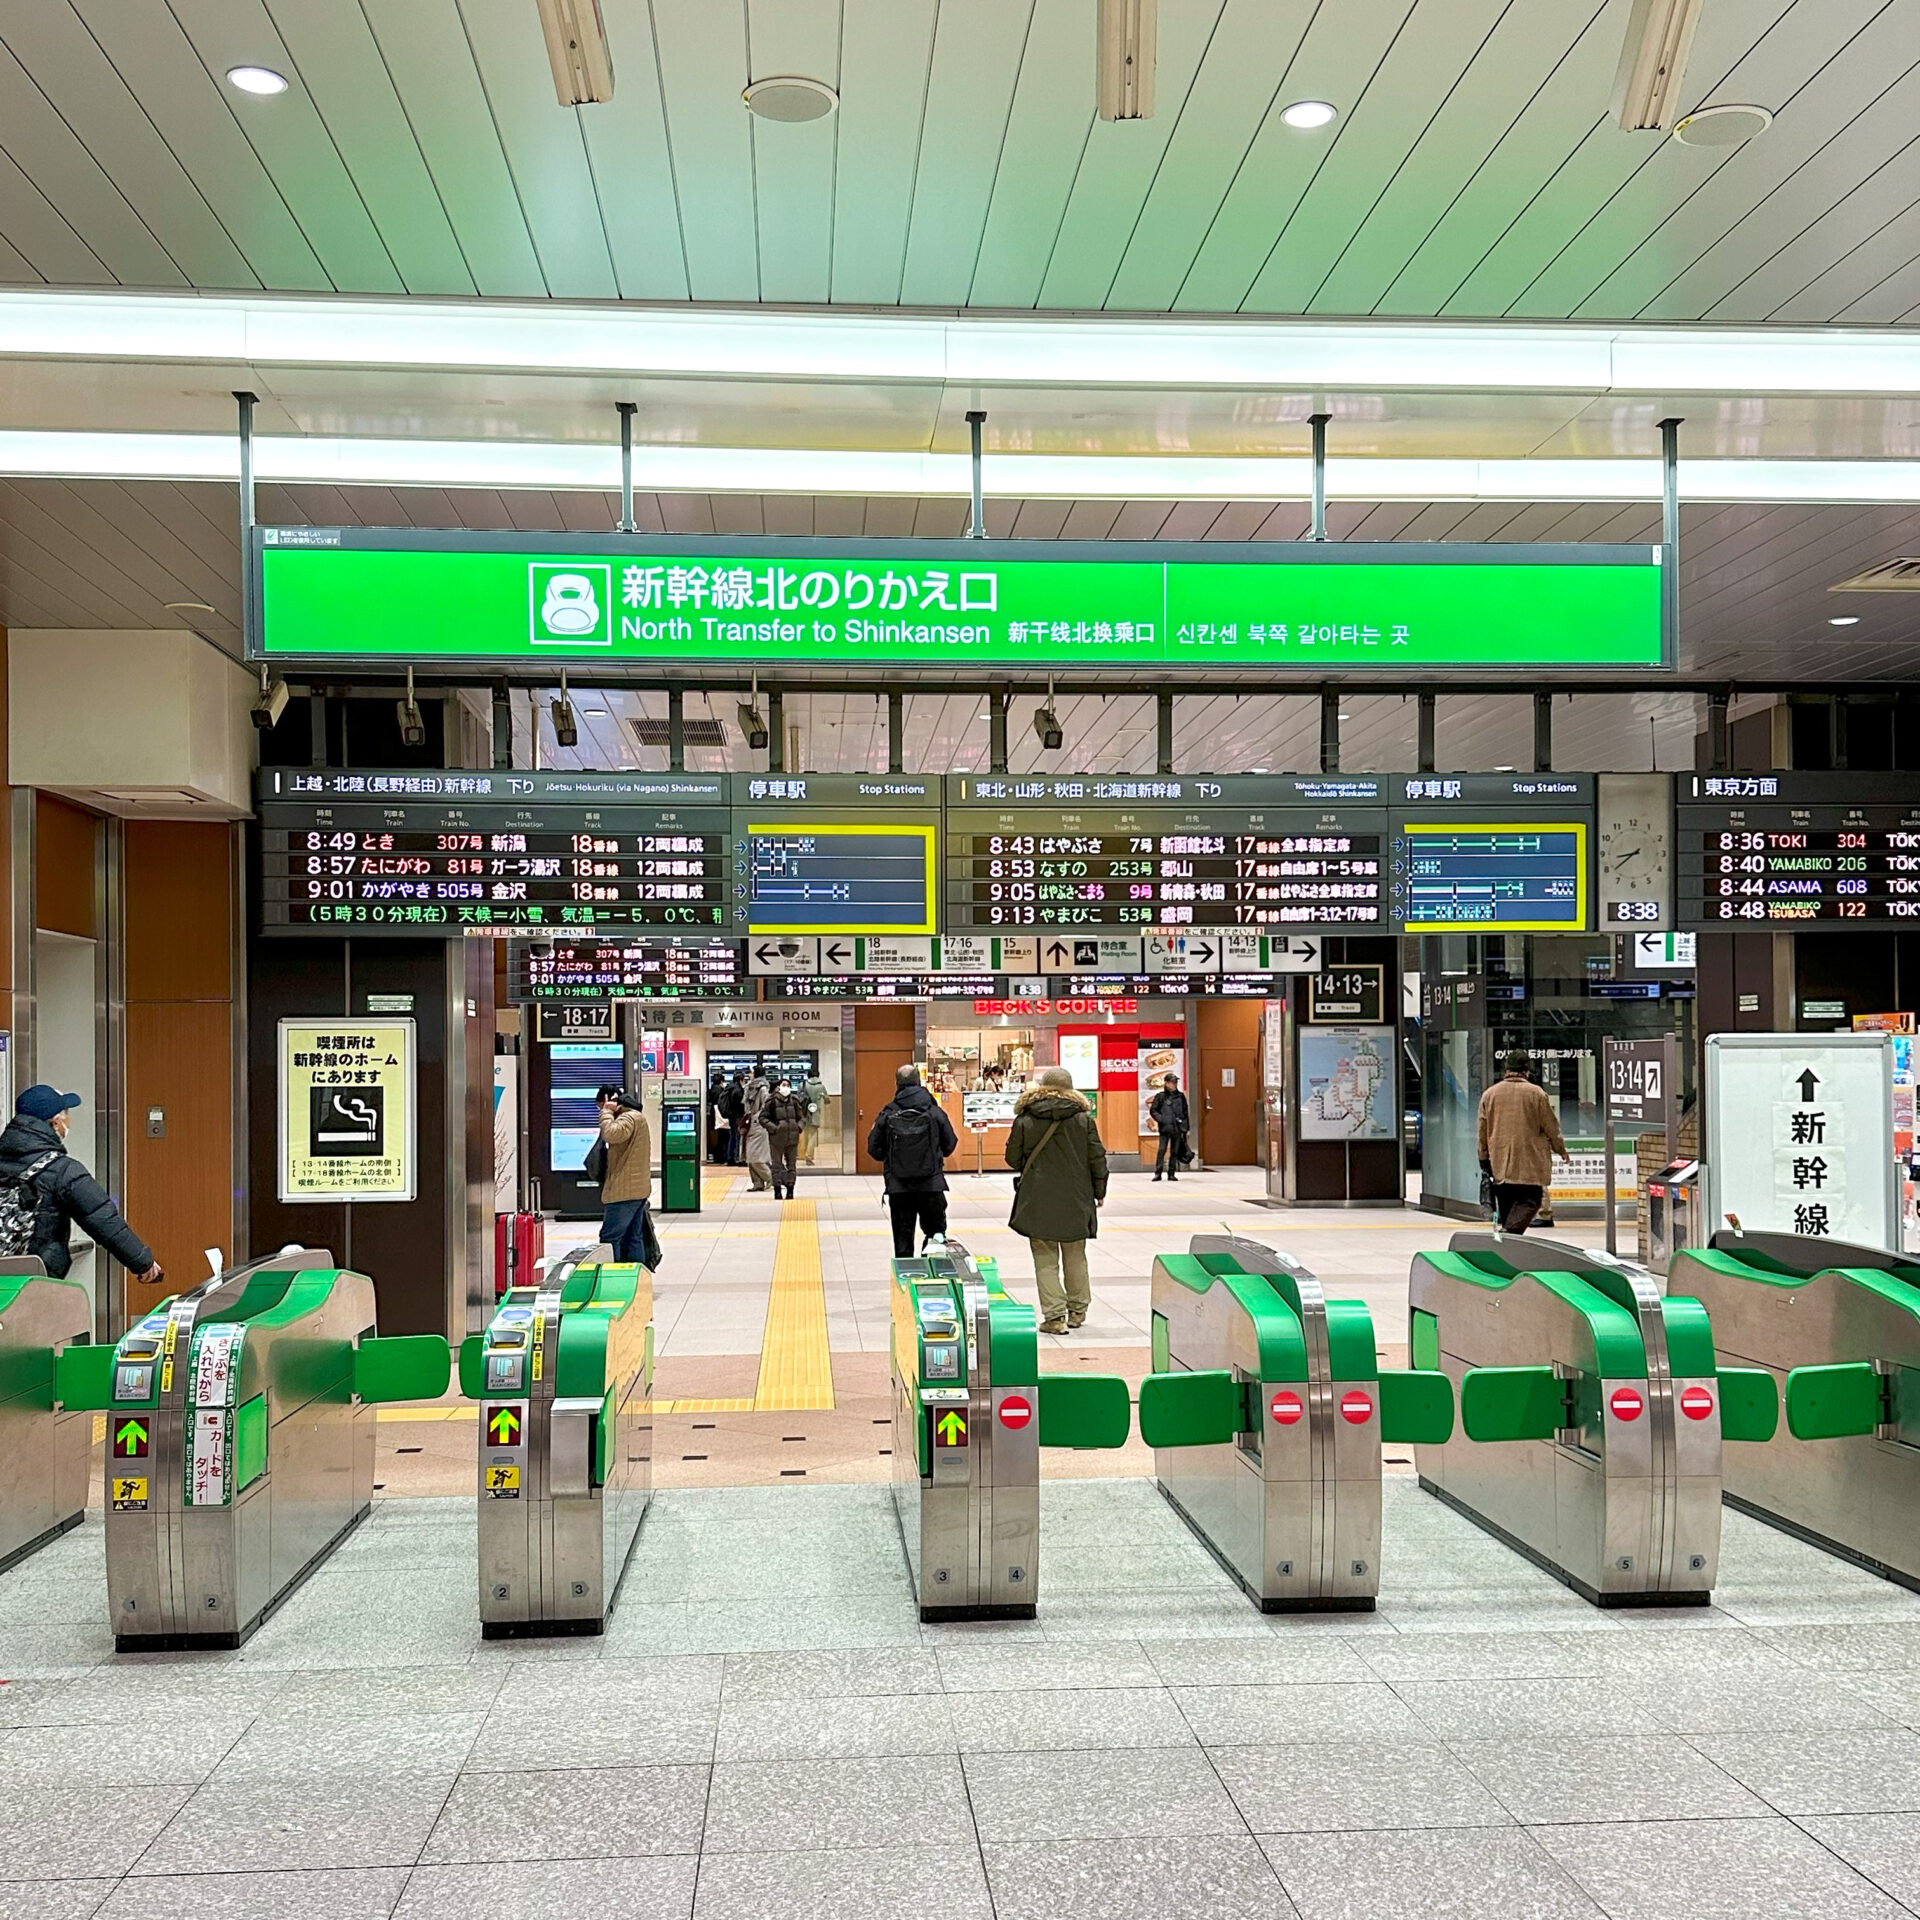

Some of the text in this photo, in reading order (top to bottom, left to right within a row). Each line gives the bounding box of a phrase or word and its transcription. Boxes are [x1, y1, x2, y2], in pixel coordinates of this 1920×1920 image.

[621, 565, 998, 612] 新幹線北のりかえ口
[621, 616, 990, 644] North Transfer to Shinkansen
[1008, 621, 1155, 644] 新干线北换乘口
[1176, 624, 1410, 646] 신칸센 북쪽 갈아타는 곳
[506, 778, 534, 794] 下り
[616, 784, 718, 794] (via Nagano) Shinkansen
[750, 780, 806, 798] 停車駅
[859, 785, 924, 795] Stop Stations
[1195, 783, 1222, 798] 下り
[1406, 780, 1461, 799] 停車駅
[1513, 784, 1577, 794] Stop Stations
[1705, 778, 1778, 796] 東京方面
[307, 832, 356, 850] 8:49
[362, 834, 394, 850] とき
[437, 835, 483, 850] 307号
[491, 835, 526, 852] 新潟
[990, 837, 1034, 854] 8:43
[1040, 838, 1102, 854] はやぶさ
[1130, 838, 1152, 852] 7号
[1720, 832, 1920, 850] 8:36 TOKI 304 TŌK
[307, 856, 356, 874] 8:57
[361, 858, 430, 874] たにがわ
[448, 860, 484, 874] 81号
[491, 859, 560, 876] ガーラ湯沢
[990, 860, 1034, 877] 8:53
[1040, 862, 1088, 876] なすの
[1110, 862, 1152, 876] 253号
[1160, 860, 1192, 877] 郡山
[1720, 856, 1920, 872] 8:40 YAMABIKO 206 TŌK
[308, 881, 354, 898] 9:01
[361, 882, 431, 898] かがやき
[437, 883, 484, 898] 505号
[492, 883, 526, 899] 金沢
[990, 883, 1035, 900] 9:05
[1129, 885, 1152, 899] 9号
[1720, 878, 1920, 896] 8:44 ASAMA 608 TŌK
[990, 906, 1034, 924] 9:13
[1040, 908, 1102, 923] やまびこ
[1119, 908, 1152, 922] 53号
[1160, 906, 1193, 923] 盛岡
[1617, 903, 1658, 920] 8:38
[1720, 902, 1764, 918] 8:48
[1838, 903, 1866, 916] 122
[1886, 901, 1920, 916] TŌK
[1768, 910, 1816, 918] TSUBASA
[868, 938, 880, 948] 18
[1004, 938, 1016, 948] 15
[1101, 942, 1127, 950] 待合室
[530, 962, 555, 972] 8:57
[530, 974, 554, 984] 9:01
[558, 974, 592, 984] かがやき
[786, 985, 810, 996] 9:13
[813, 986, 846, 994] やまびこ
[1020, 986, 1041, 994] 8:38
[1070, 985, 1095, 995] 8:48
[1134, 985, 1150, 994] 122
[1056, 1000, 1138, 1014] COFFEE
[653, 1010, 704, 1024] 待合室
[718, 1012, 820, 1021] WAITING ROOM
[316, 1036, 375, 1049] 喫煙所は
[294, 1054, 398, 1067] 新幹線のホーム
[1101, 1059, 1138, 1067] BECK'S
[312, 1071, 380, 1084] にあります
[1791, 1111, 1830, 1236] 新幹線
[199, 1346, 214, 1402] 入れてから
[210, 1431, 222, 1476] カードを
[1282, 1564, 1290, 1574] 4
[1355, 1563, 1362, 1574] 5
[1622, 1558, 1629, 1570] 5
[1692, 1558, 1700, 1568] 6
[939, 1571, 946, 1581] 3
[1012, 1570, 1019, 1579] 4
[500, 1587, 506, 1597] 2
[576, 1584, 583, 1594] 3
[130, 1600, 136, 1608] 1
[208, 1598, 216, 1608] 2
